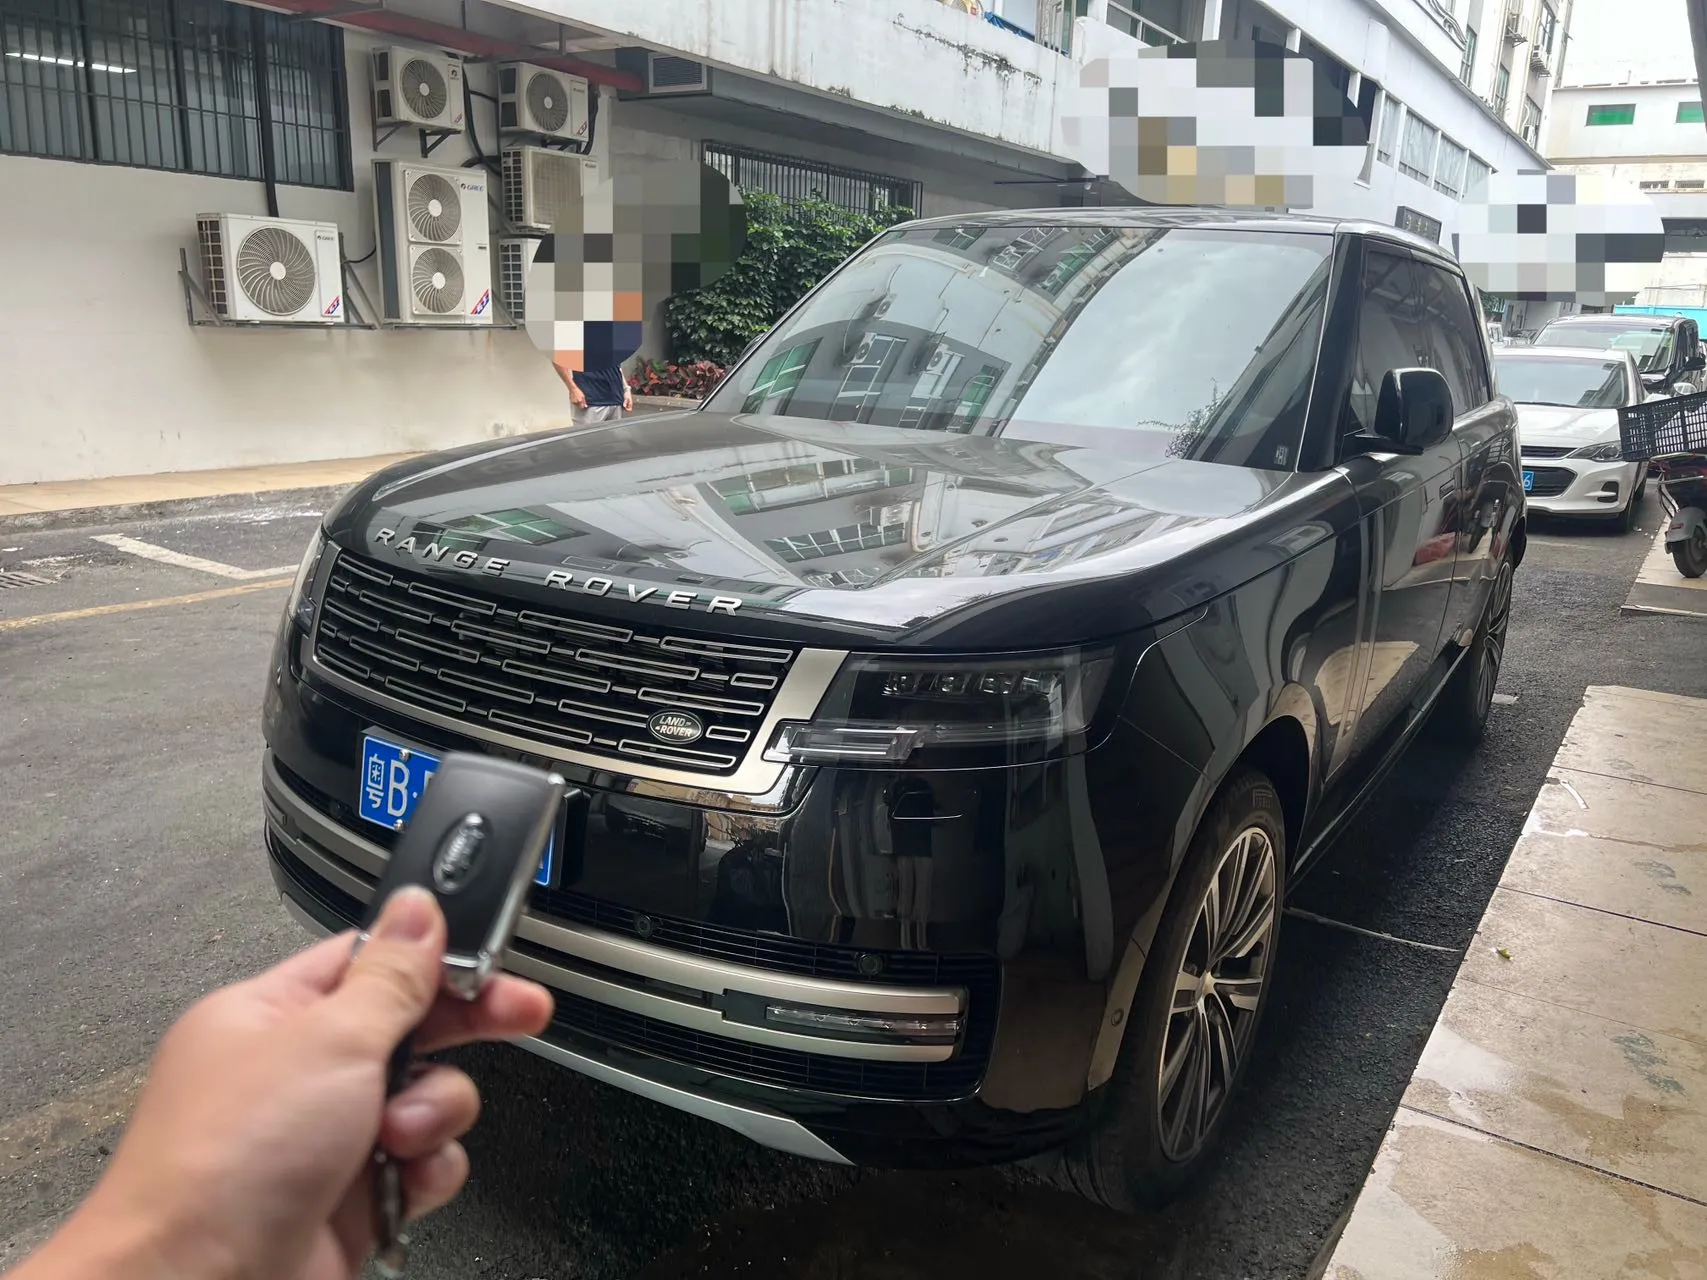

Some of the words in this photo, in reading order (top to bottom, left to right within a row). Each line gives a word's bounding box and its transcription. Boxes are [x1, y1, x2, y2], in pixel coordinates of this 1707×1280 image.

[374, 527, 511, 576] RANGE
[544, 570, 743, 617] ROVER
[659, 715, 686, 727] LAND
[660, 725, 693, 737] ROVER
